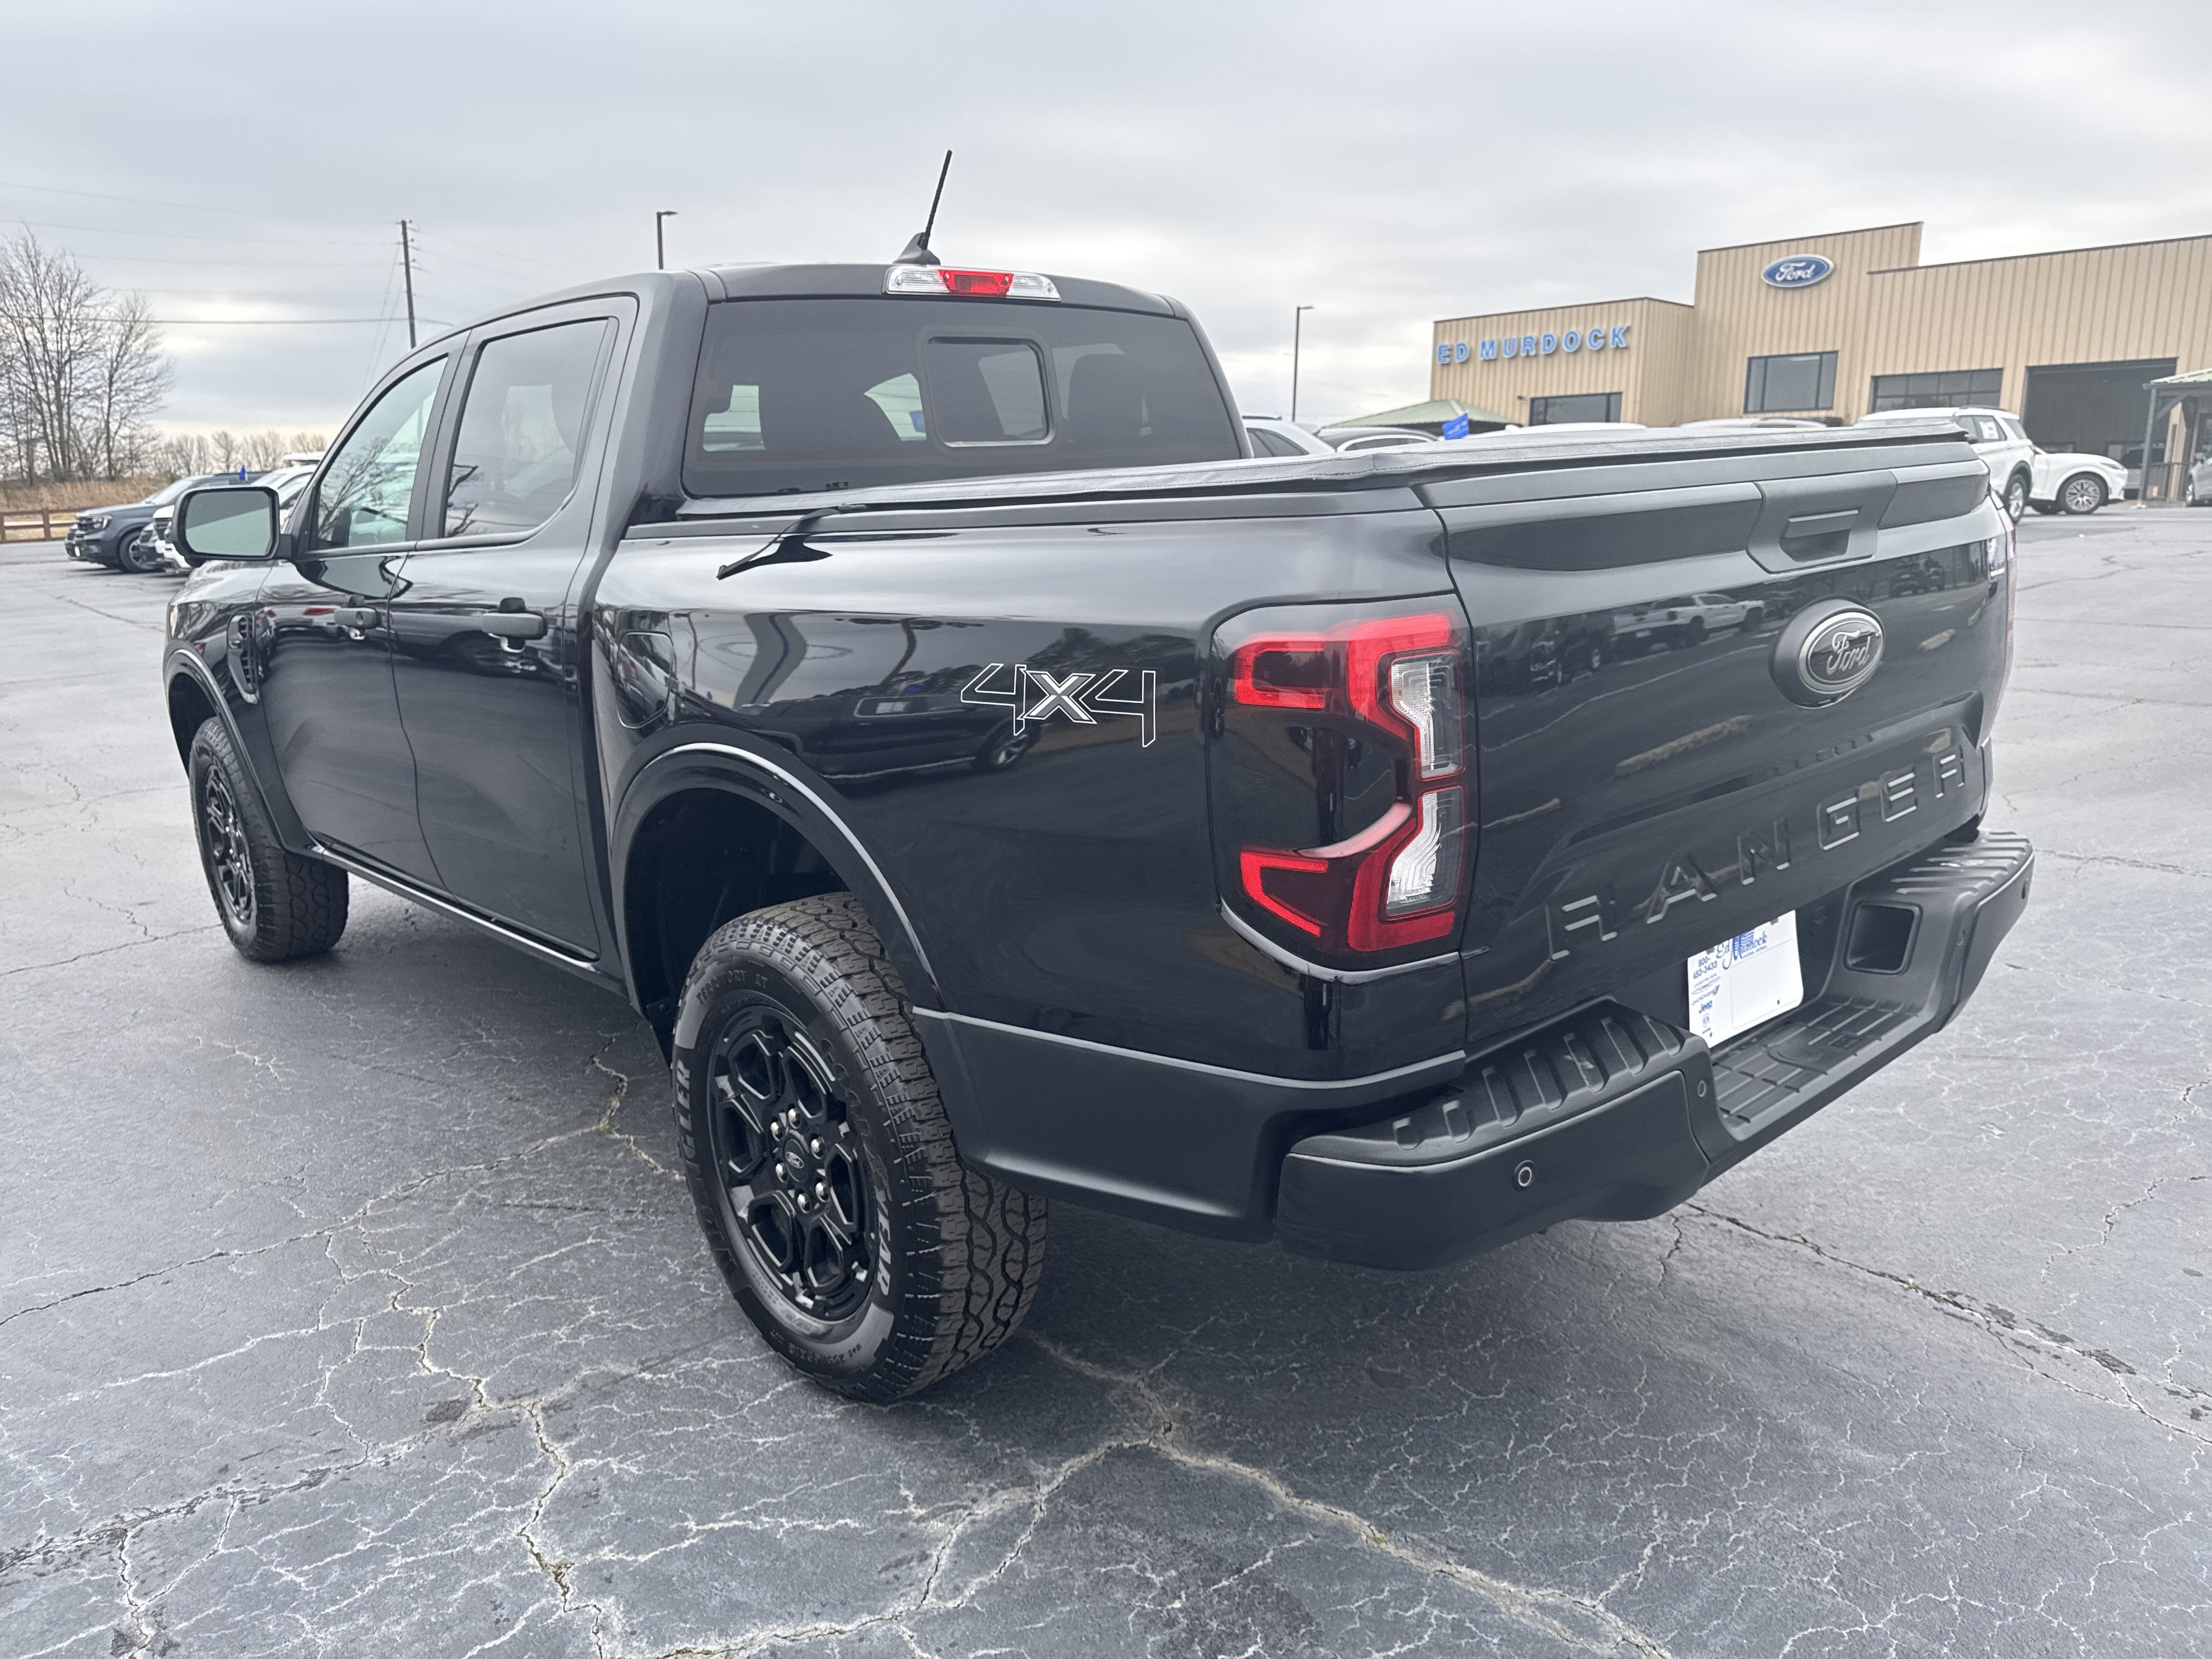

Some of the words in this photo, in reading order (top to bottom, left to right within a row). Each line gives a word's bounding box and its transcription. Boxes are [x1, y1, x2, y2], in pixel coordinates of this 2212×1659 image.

[1775, 261, 1816, 281] Ford
[1437, 343, 1469, 364] ED
[1480, 325, 1631, 360] MURDOCK
[1826, 629, 1872, 675] Ford
[1545, 744, 1965, 961] RANGER
[1699, 1000, 1713, 1014] Jeep
